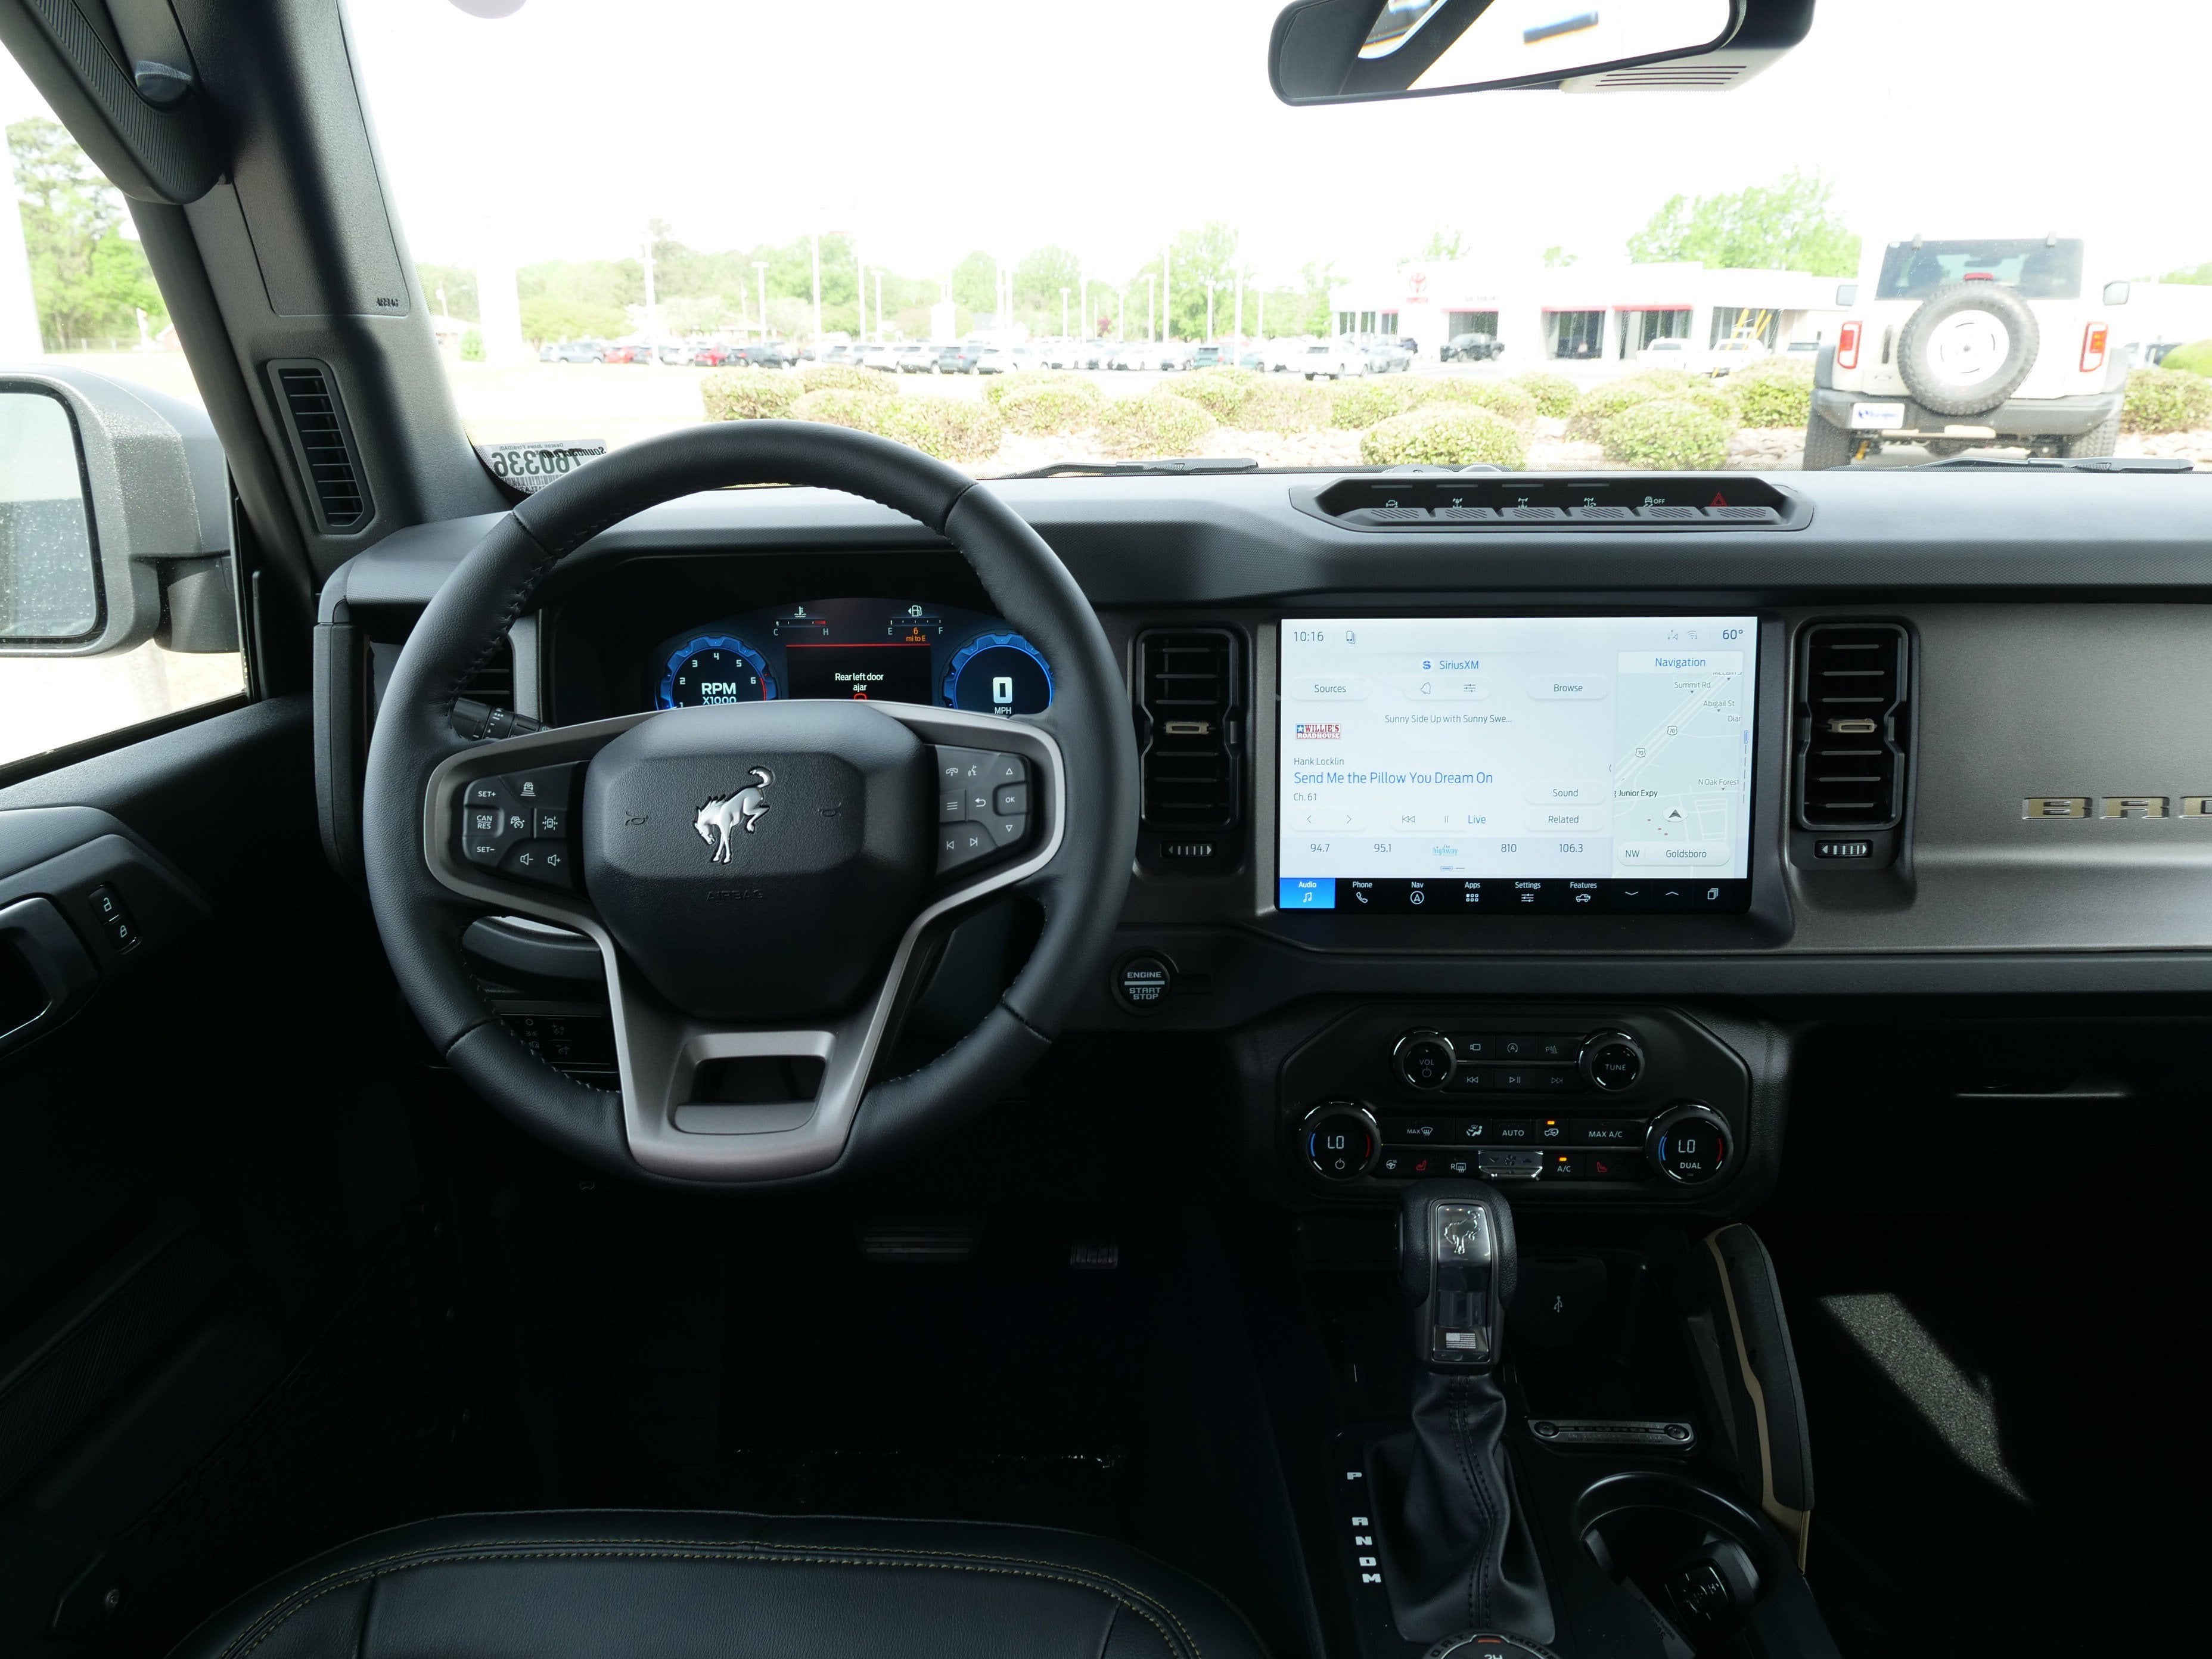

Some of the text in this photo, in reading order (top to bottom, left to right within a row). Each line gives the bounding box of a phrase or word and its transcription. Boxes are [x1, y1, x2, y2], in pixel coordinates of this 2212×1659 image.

[773, 628, 779, 636] C
[822, 627, 829, 636] H
[913, 627, 919, 635] 6
[1722, 629, 1744, 640] 60°
[1293, 630, 1324, 642] 10:16
[713, 652, 720, 660] 4
[691, 660, 698, 668] 3
[736, 659, 742, 667] 5
[1439, 660, 1480, 670] SiriusXM
[1655, 657, 1706, 669] Navigation
[679, 677, 686, 685] 2
[750, 676, 757, 685] 6
[834, 672, 884, 681] Rear left door
[701, 682, 737, 695] RPM
[853, 683, 867, 692] ajar
[993, 676, 1013, 704] 0
[1313, 684, 1347, 694] Sources
[1553, 684, 1583, 692] Browse
[1703, 699, 1735, 708] Abigail St
[994, 706, 1012, 714] MPH
[1384, 714, 1512, 725] Sunny Side Up with Sunny Swe...
[1304, 724, 1340, 733] WILLIE'S
[1294, 757, 1344, 766] Hank Locklin
[1294, 772, 1493, 784] Send Me the Pillow You Dream On
[1293, 793, 1317, 801] Ch. 61
[1552, 788, 1579, 797] Sound
[1618, 789, 1640, 797] Junior
[1641, 789, 1658, 798] Expy
[1468, 815, 1487, 825] Live
[1548, 815, 1579, 824] Related
[1310, 843, 1330, 853] 94.7
[1374, 843, 1392, 853] 95.1
[1433, 846, 1458, 856] highway
[1500, 843, 1518, 853] 810
[1559, 843, 1583, 853] 106.3
[1624, 850, 1641, 858] NW
[1665, 849, 1707, 859] Goldsboro
[1464, 881, 1481, 890] Apps
[1515, 881, 1541, 890] Settings
[1570, 881, 1598, 889] Features
[706, 889, 763, 901] AIRBAG
[1605, 1063, 1627, 1071] TUNE
[1608, 1130, 1623, 1139] A/C
[1327, 1135, 1344, 1150] LO
[1677, 1139, 1696, 1154] LO
[1346, 1471, 1362, 1481] P
[1352, 1517, 1369, 1526] R
[1354, 1536, 1372, 1546] N
[1362, 1573, 1381, 1583] M
